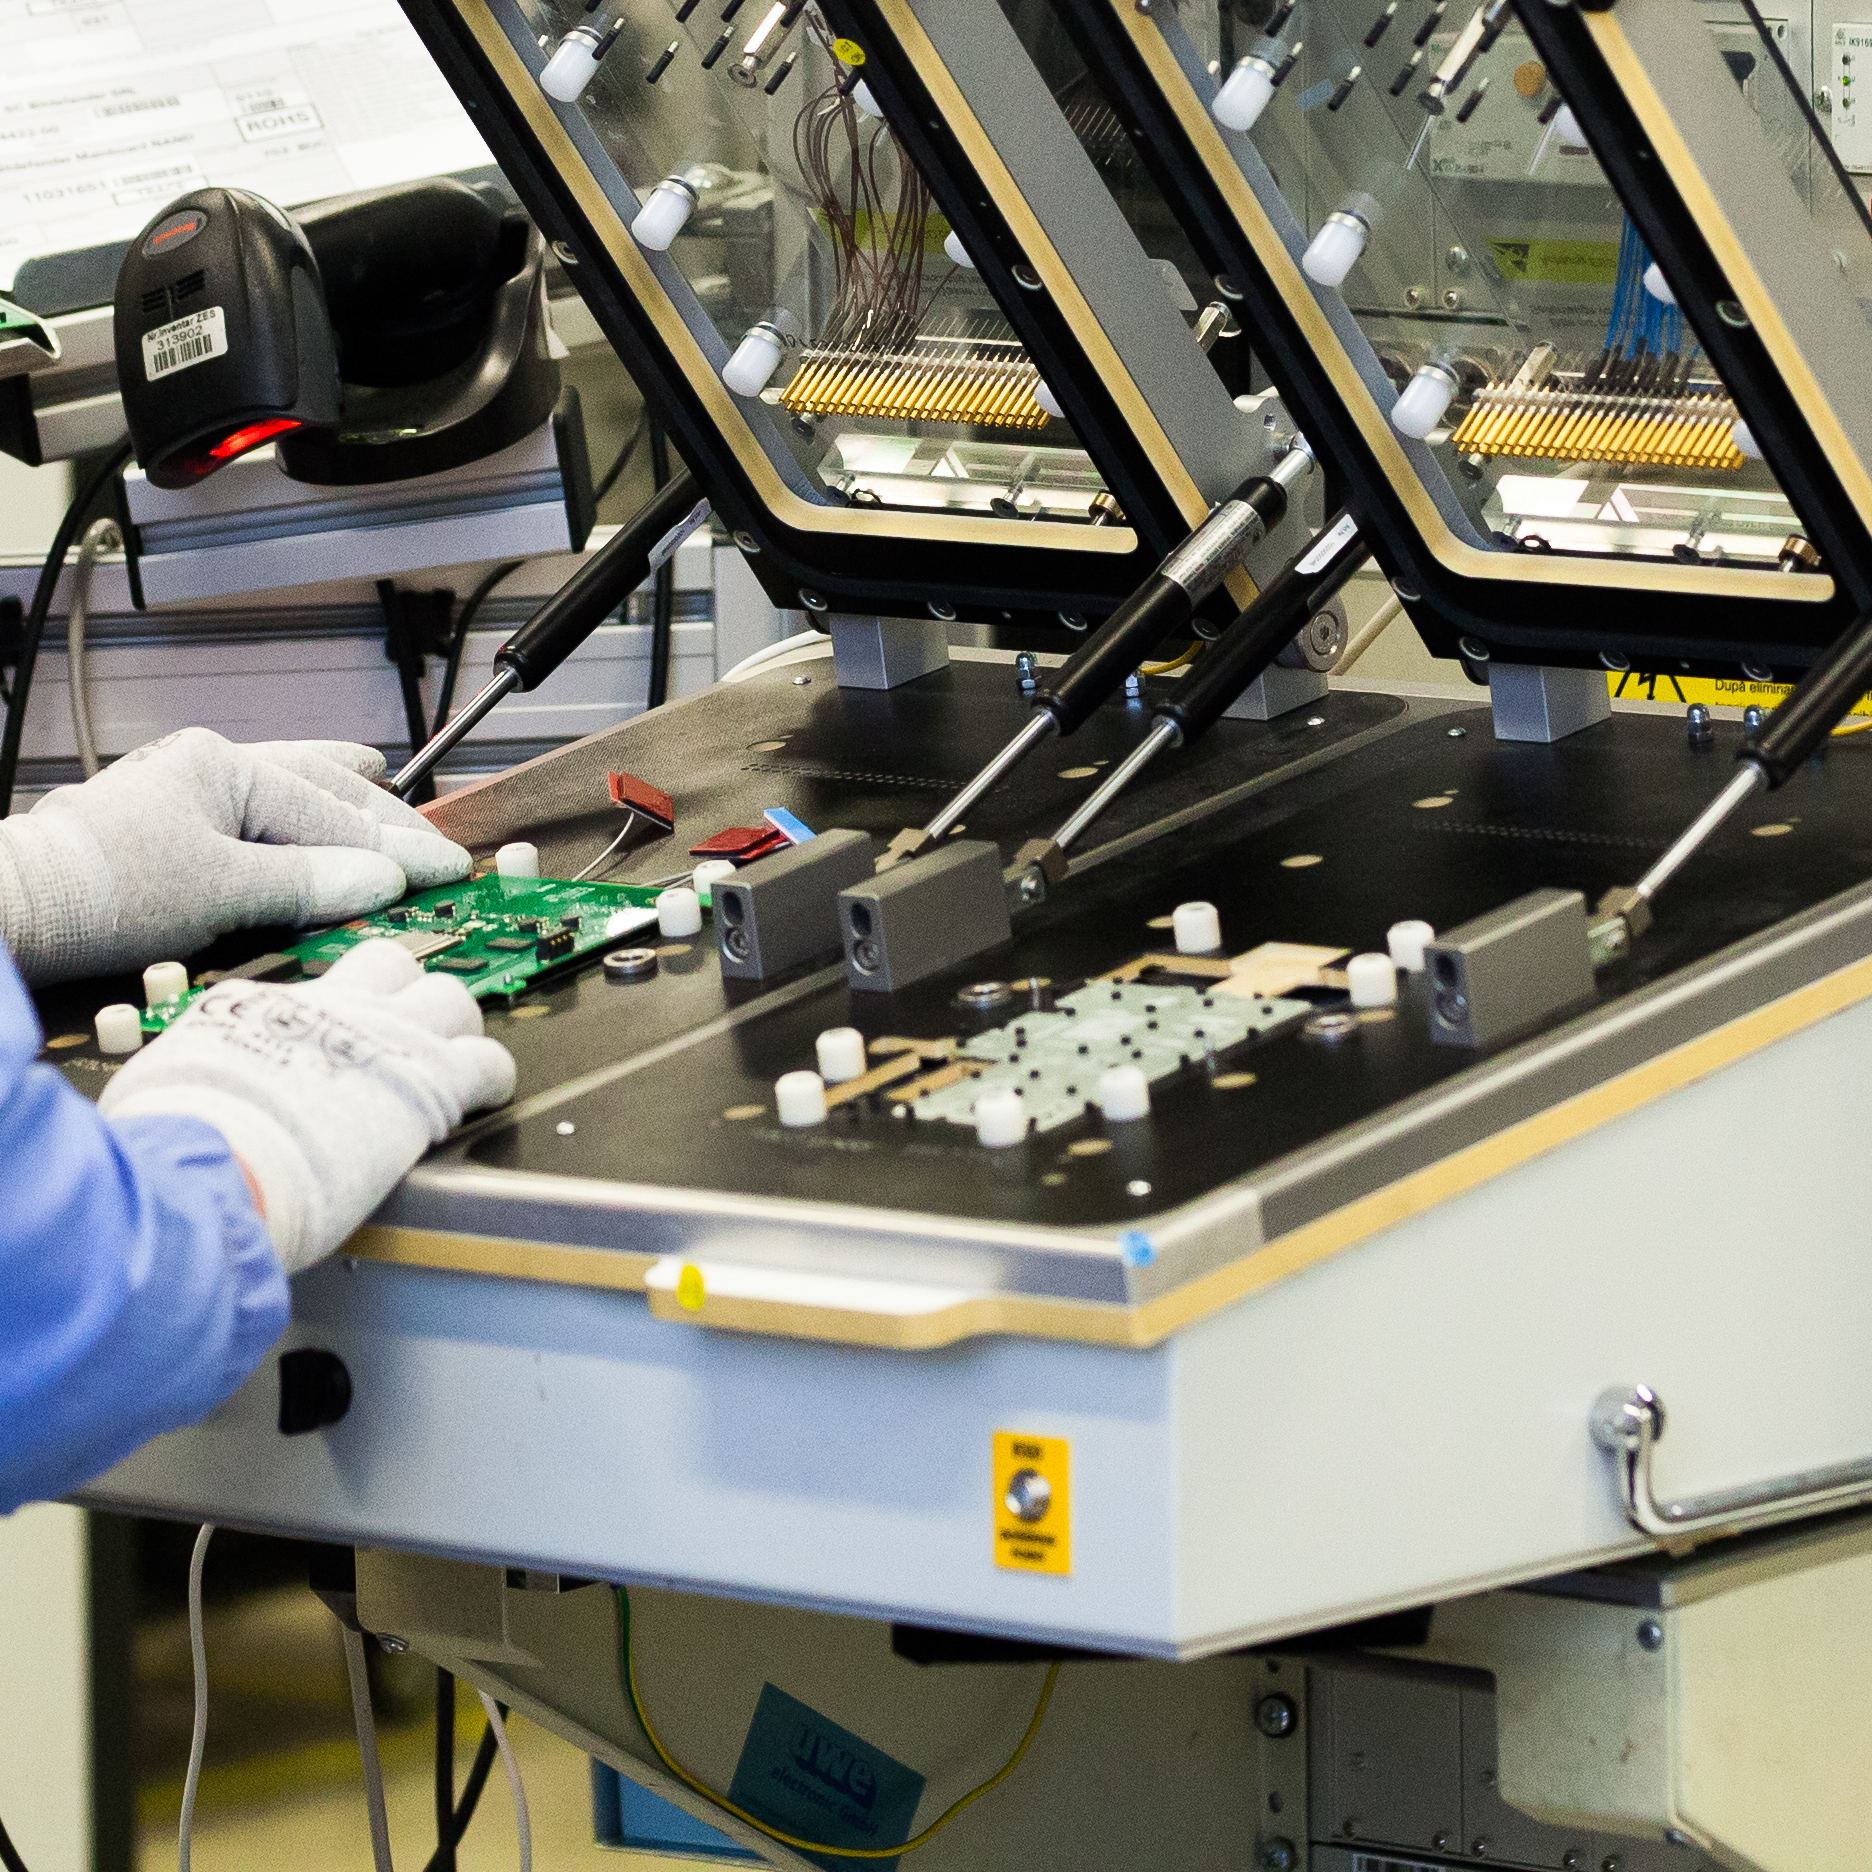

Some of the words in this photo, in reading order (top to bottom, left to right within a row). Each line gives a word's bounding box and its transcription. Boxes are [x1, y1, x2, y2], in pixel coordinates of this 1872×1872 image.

[246, 110, 310, 133] ROHS
[196, 310, 216, 323] ZES
[157, 325, 202, 351] 313902
